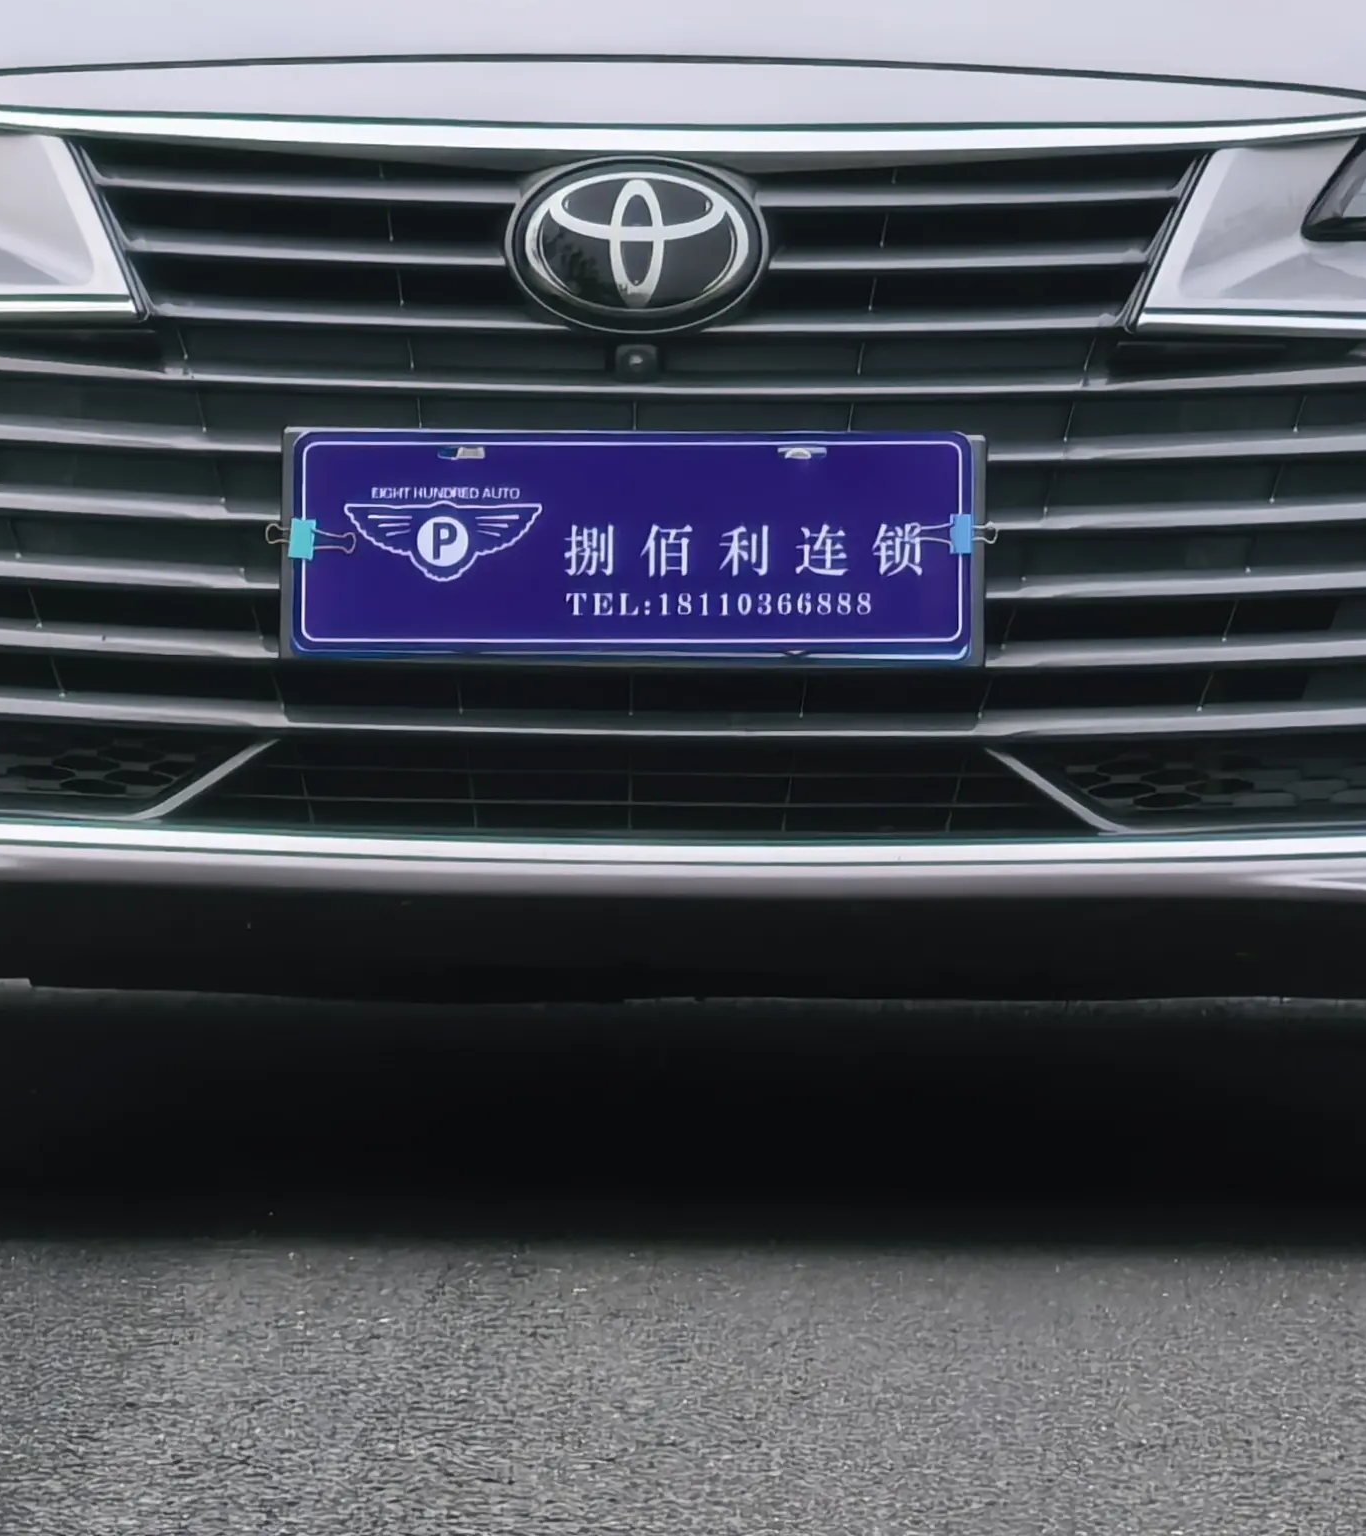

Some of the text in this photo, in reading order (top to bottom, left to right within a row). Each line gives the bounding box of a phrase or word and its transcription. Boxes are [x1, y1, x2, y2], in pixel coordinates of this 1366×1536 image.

[370, 486, 521, 499] EIGHT HUNDRED AUTO
[432, 521, 458, 561] P
[563, 523, 924, 577] 捌佰利连锁
